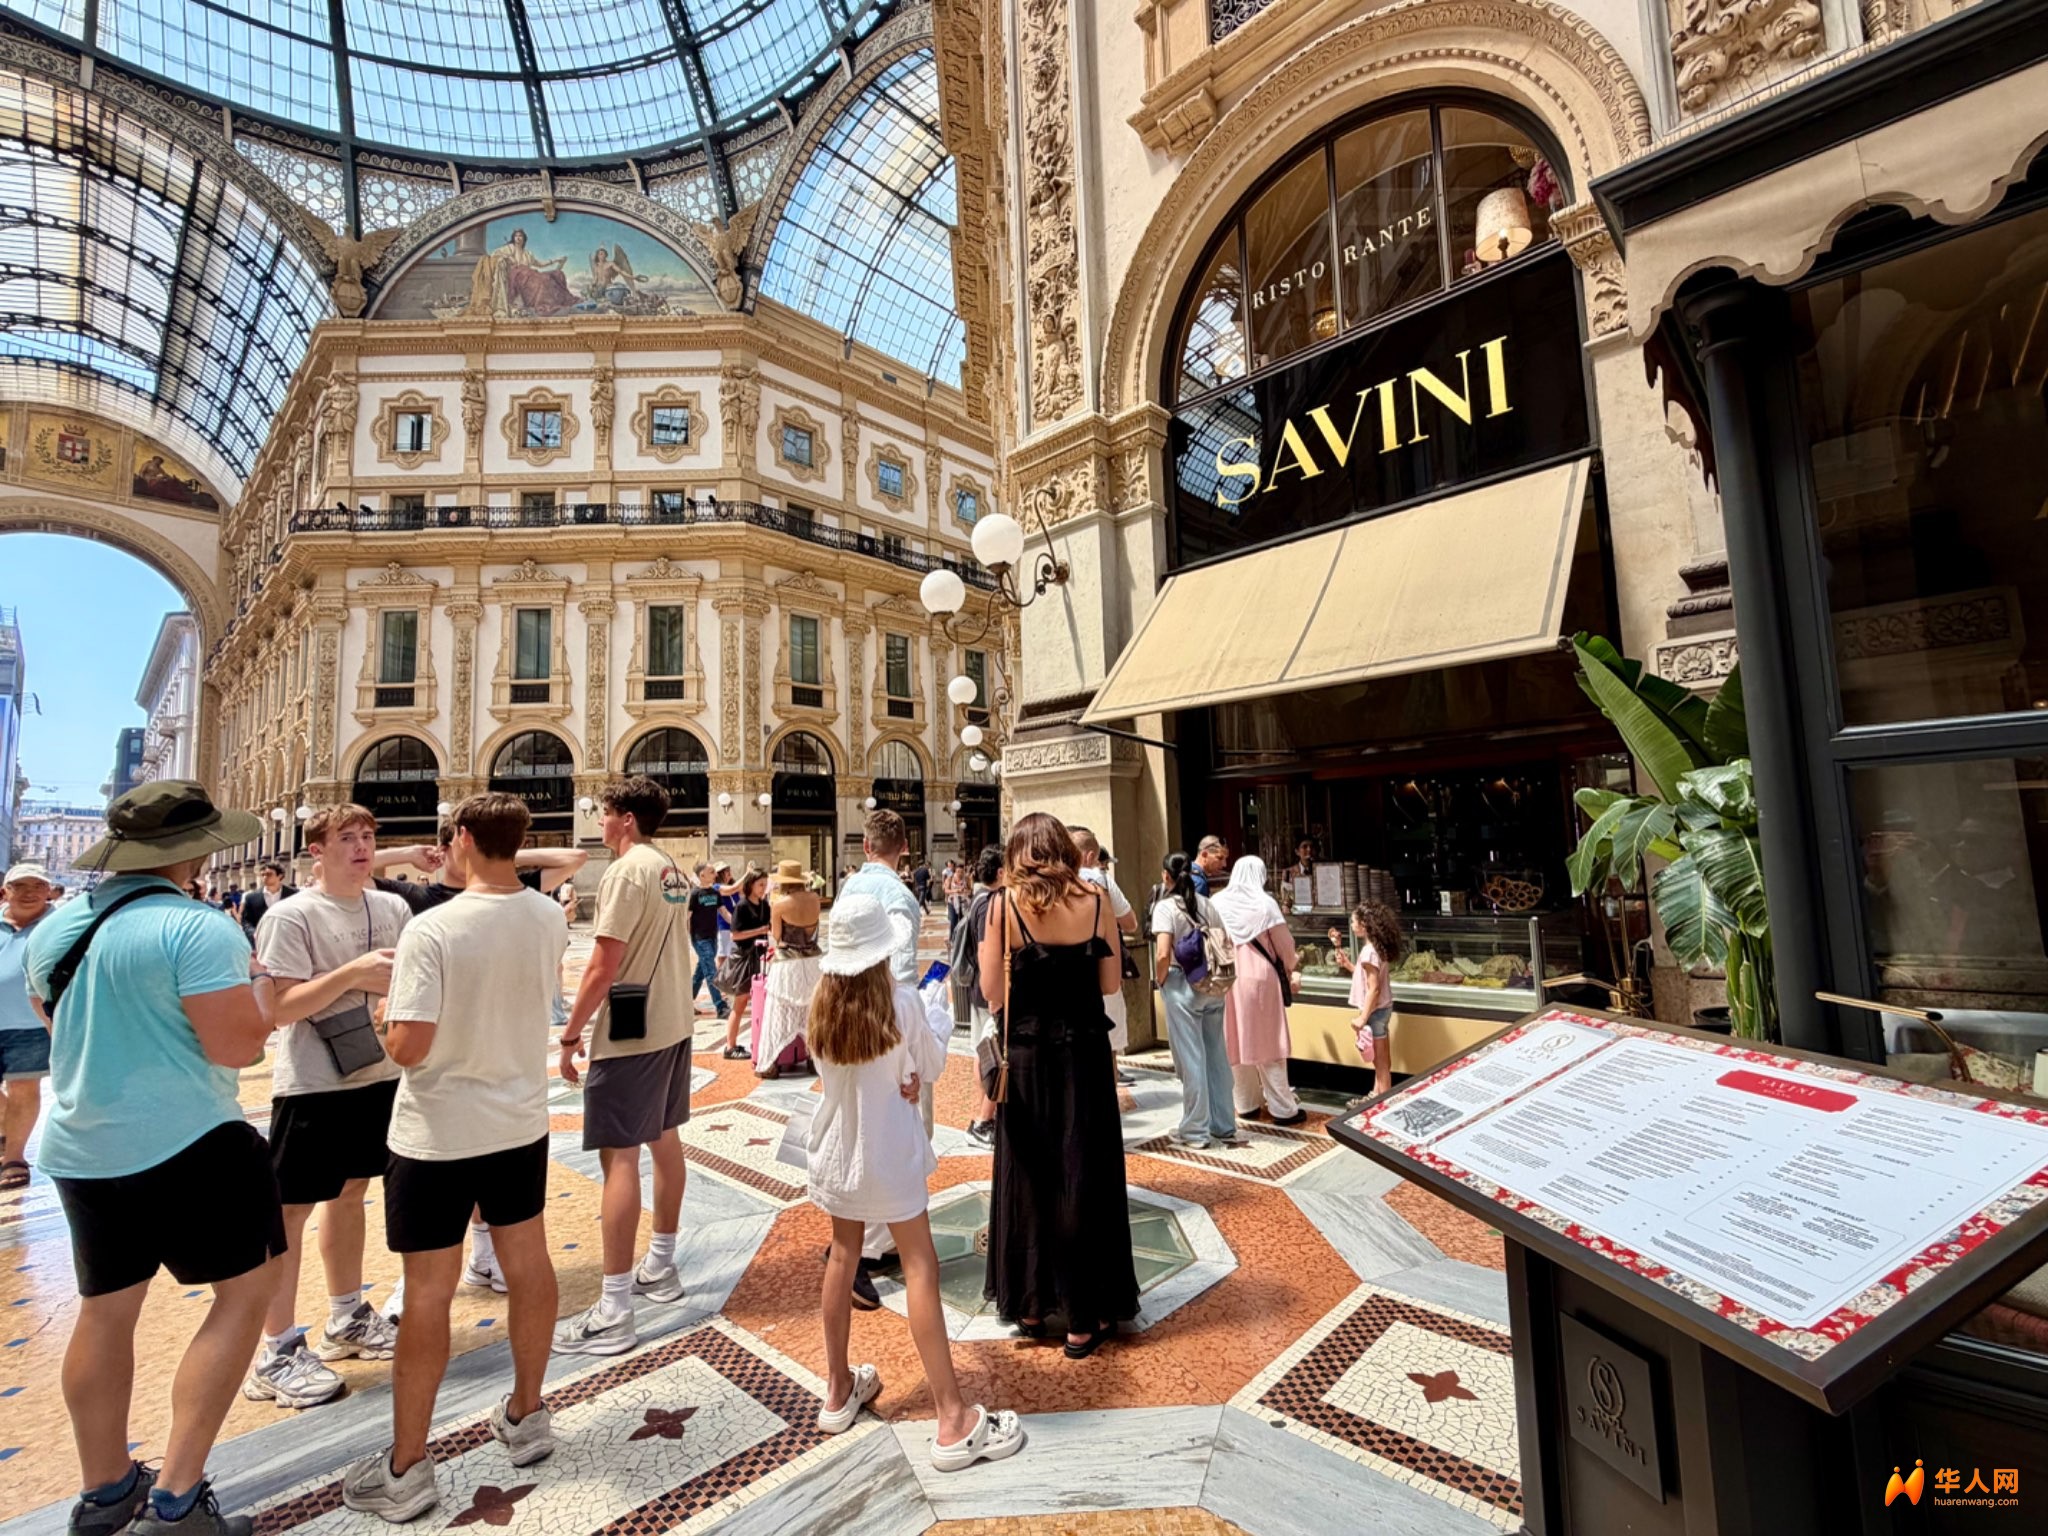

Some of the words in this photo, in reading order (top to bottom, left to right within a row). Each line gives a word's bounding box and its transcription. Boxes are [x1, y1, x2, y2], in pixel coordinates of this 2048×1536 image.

[1215, 335, 1514, 508] SAVINI
[376, 794, 417, 804] PRADA
[786, 788, 820, 798] PRADA
[1758, 1078, 1818, 1097] SAVINI
[1576, 1405, 1647, 1466] SAVINI
